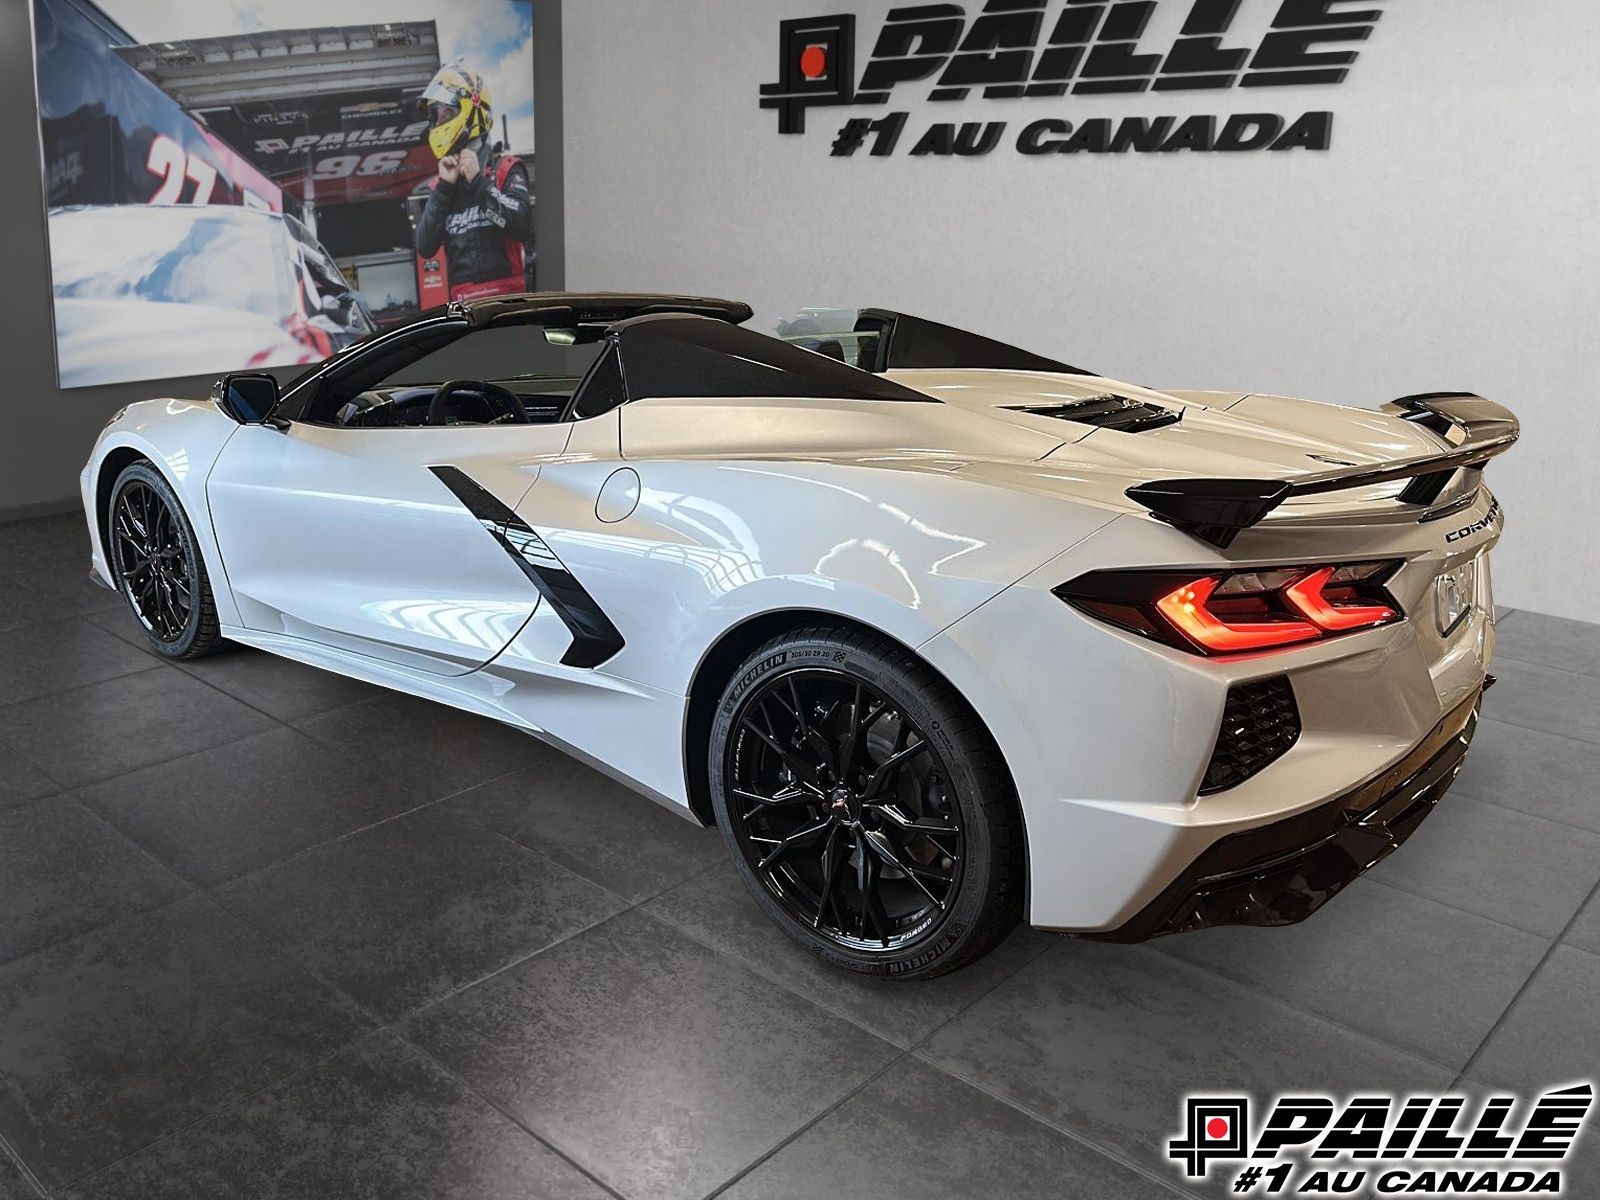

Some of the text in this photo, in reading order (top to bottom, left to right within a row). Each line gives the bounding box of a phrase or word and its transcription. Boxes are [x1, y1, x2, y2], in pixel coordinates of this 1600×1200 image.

[347, 135, 421, 149] CANADA
[830, 111, 1334, 156] #1 AU CANADA
[313, 150, 408, 181] 96
[733, 653, 785, 699] MICHELIN
[888, 936, 951, 974] MICHELIN
